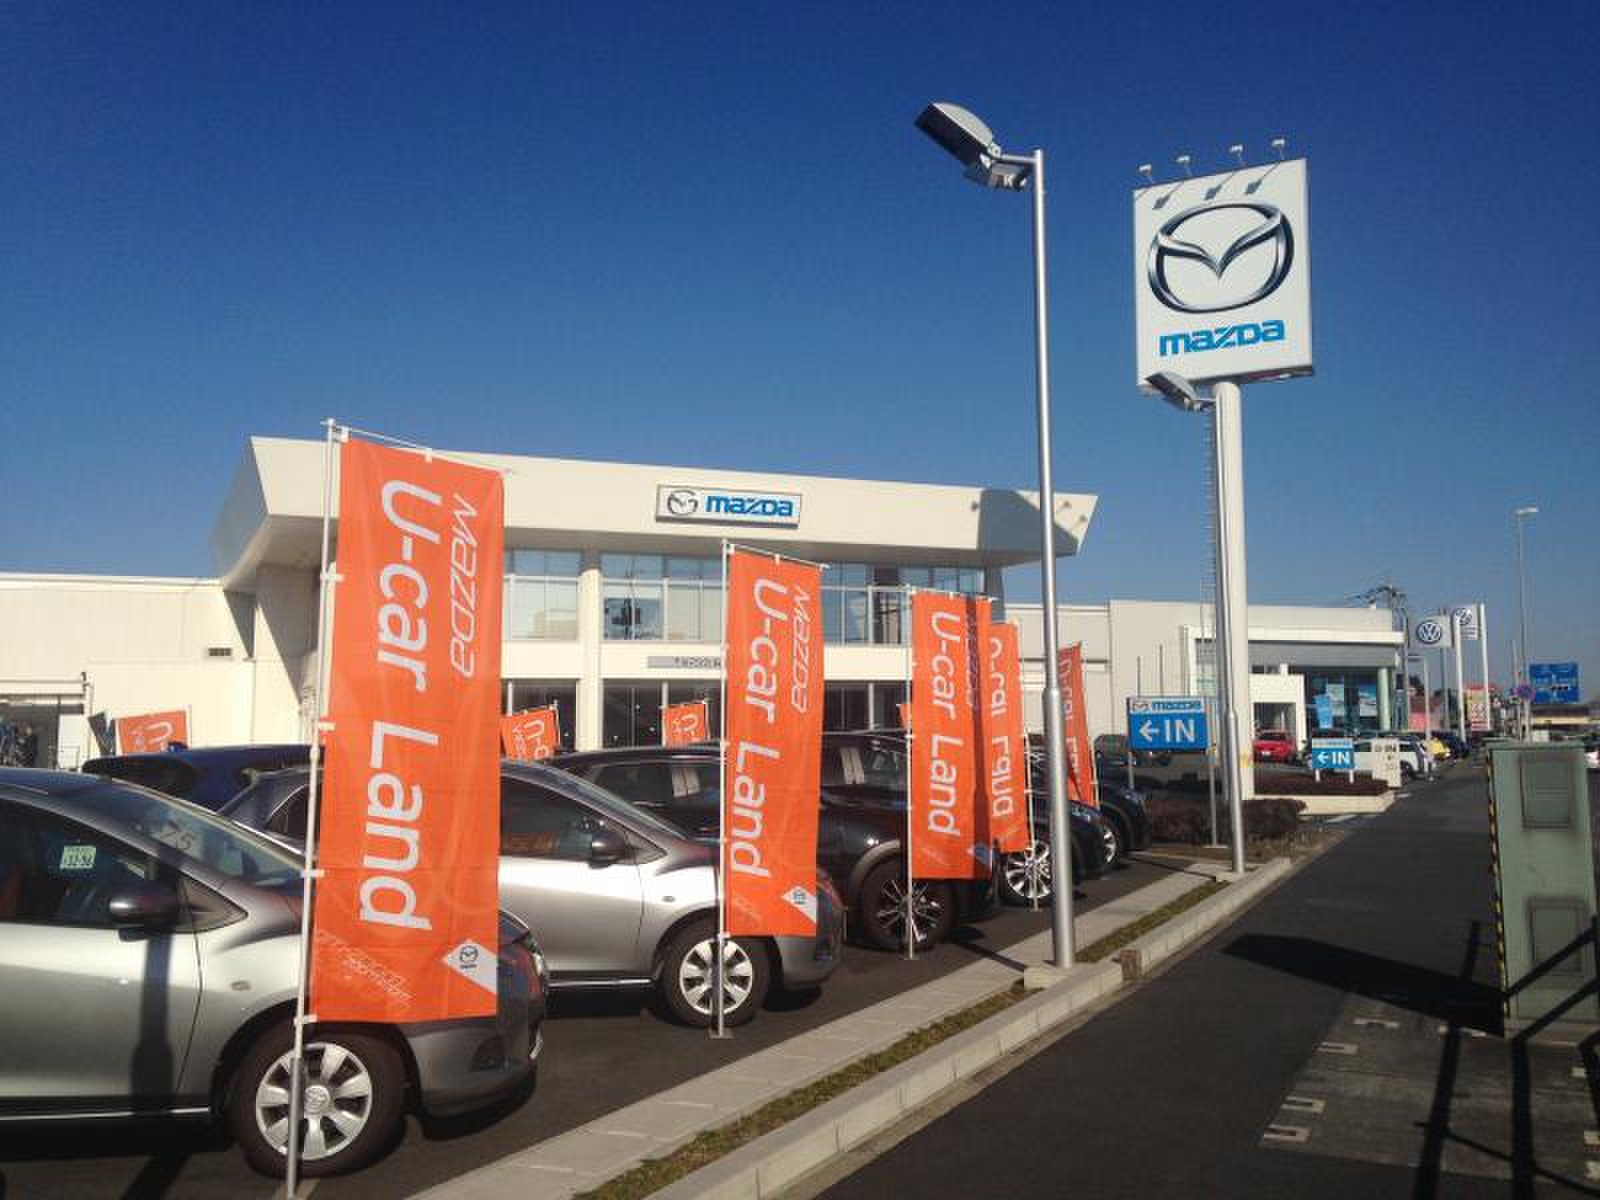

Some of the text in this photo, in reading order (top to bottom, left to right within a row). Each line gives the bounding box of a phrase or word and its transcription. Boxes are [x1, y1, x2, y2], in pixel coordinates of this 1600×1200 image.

[1159, 319, 1285, 357] mazda
[706, 495, 793, 517] mazda
[377, 480, 442, 692] U-car
[746, 578, 788, 724] U-car
[928, 611, 963, 836] U-car Land
[1165, 719, 1195, 743] IN
[1332, 751, 1350, 765] IN
[359, 720, 440, 931] Land
[731, 741, 780, 878] Land
